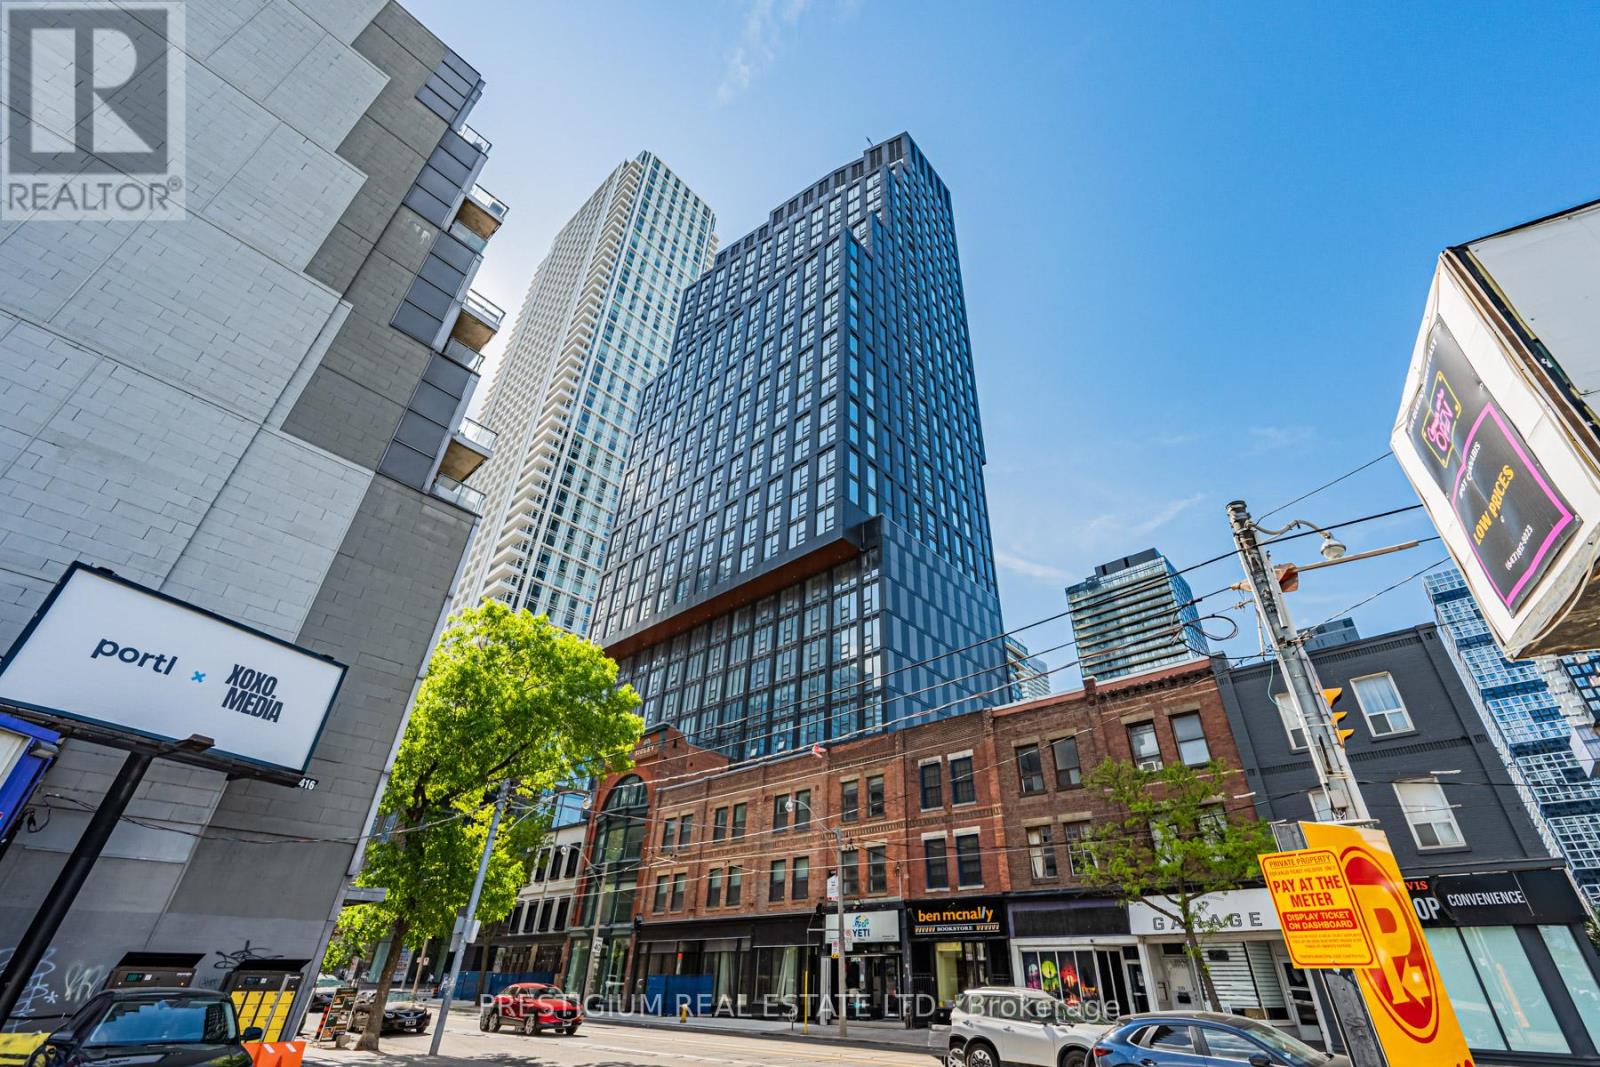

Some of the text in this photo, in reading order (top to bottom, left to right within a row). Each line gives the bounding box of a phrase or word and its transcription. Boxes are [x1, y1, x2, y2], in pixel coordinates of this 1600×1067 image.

[1436, 400, 1453, 452] OPEN
[1473, 464, 1514, 546] LOW PRICES
[90, 638, 178, 676] portl
[221, 687, 284, 723] MEDIA
[299, 778, 316, 790] 416
[1269, 855, 1331, 867] PRIVATE PROPERTY
[1273, 875, 1343, 893] PAY AT THE
[1290, 893, 1334, 908] METER
[1446, 890, 1526, 907] CONVENIENCE
[918, 906, 994, 922] ben mcnally
[1286, 911, 1350, 922] DISPLAY TICKET
[1288, 919, 1354, 930] ON DASHBOARD
[852, 928, 871, 938] YETI
